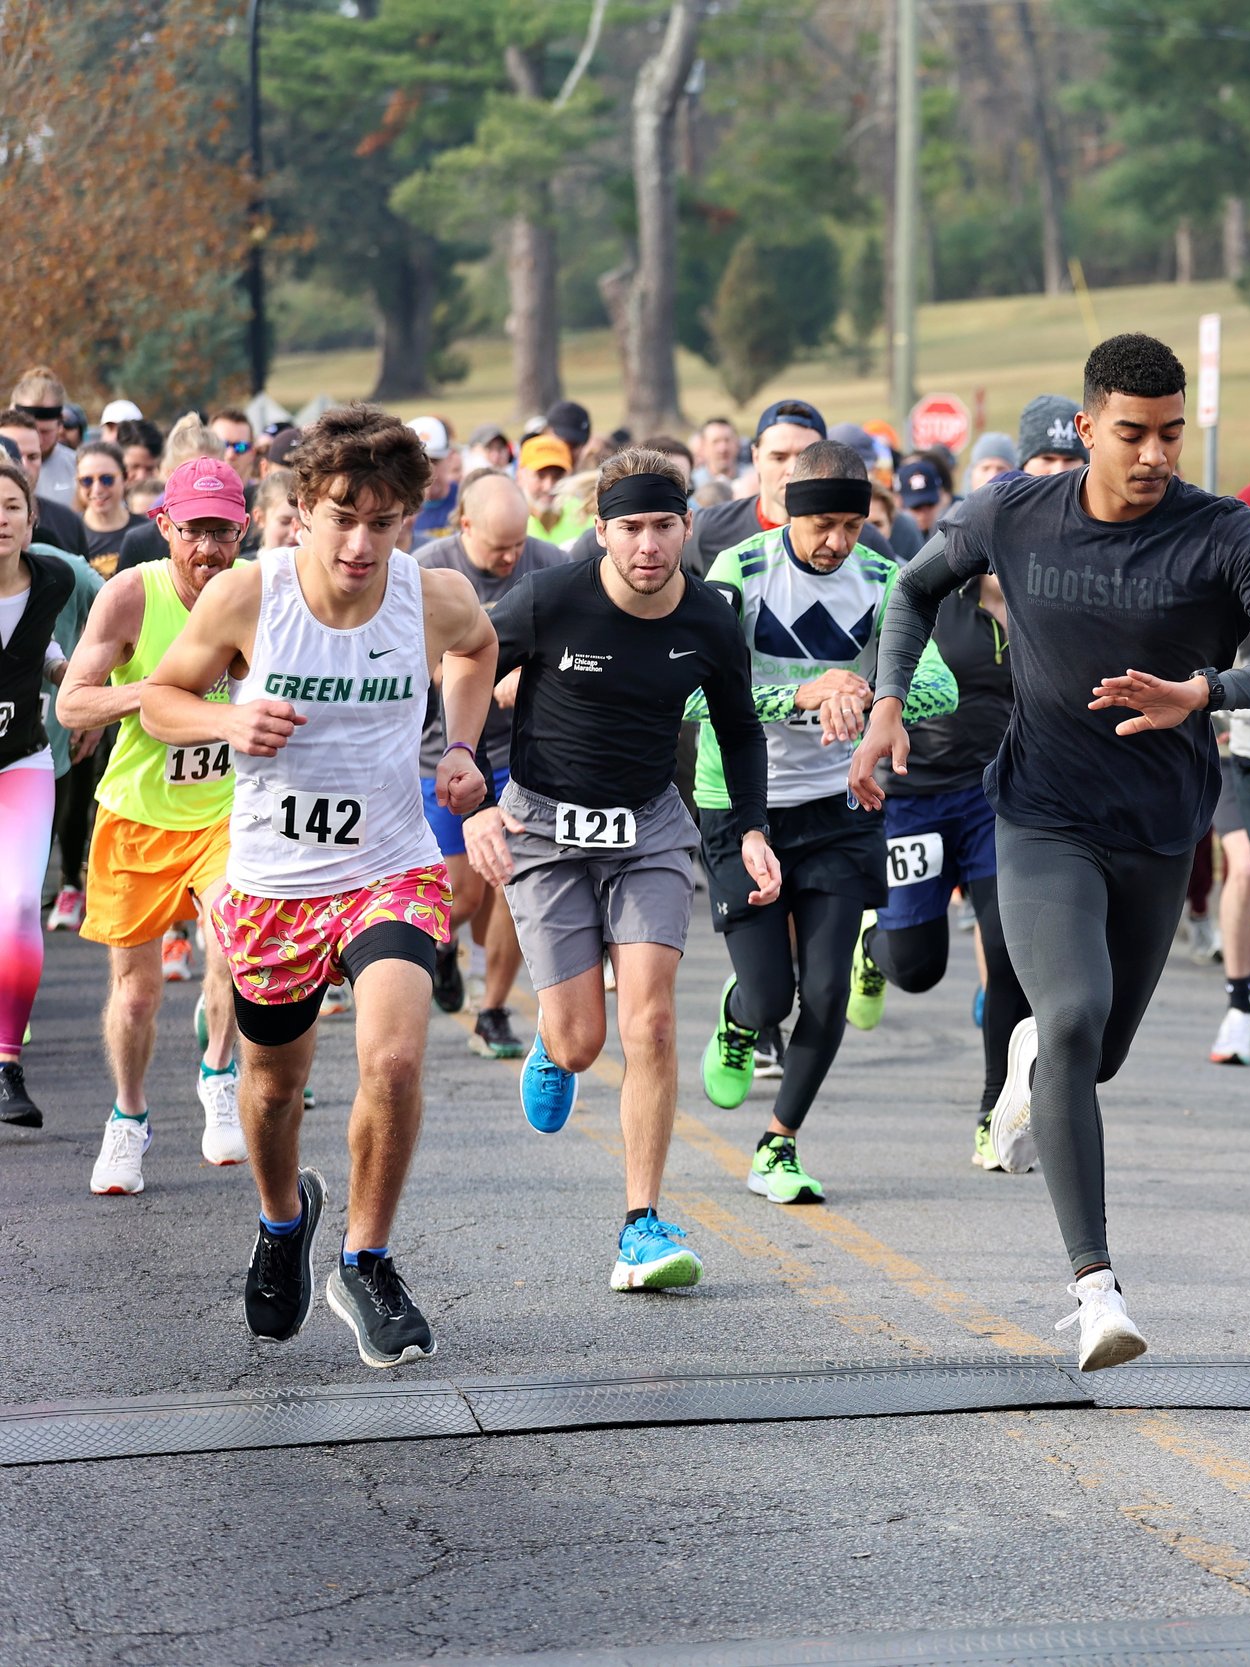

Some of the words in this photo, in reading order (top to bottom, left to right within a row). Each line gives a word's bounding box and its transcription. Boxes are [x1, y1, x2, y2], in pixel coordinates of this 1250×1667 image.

[1027, 552, 1174, 618] bootstrap
[574, 658, 598, 666] Chicago
[574, 664, 602, 672] Marathon
[264, 673, 354, 703] GREEN
[358, 674, 414, 703] HILL
[170, 743, 231, 781] 134
[279, 795, 362, 845] 142
[562, 809, 630, 845] 121
